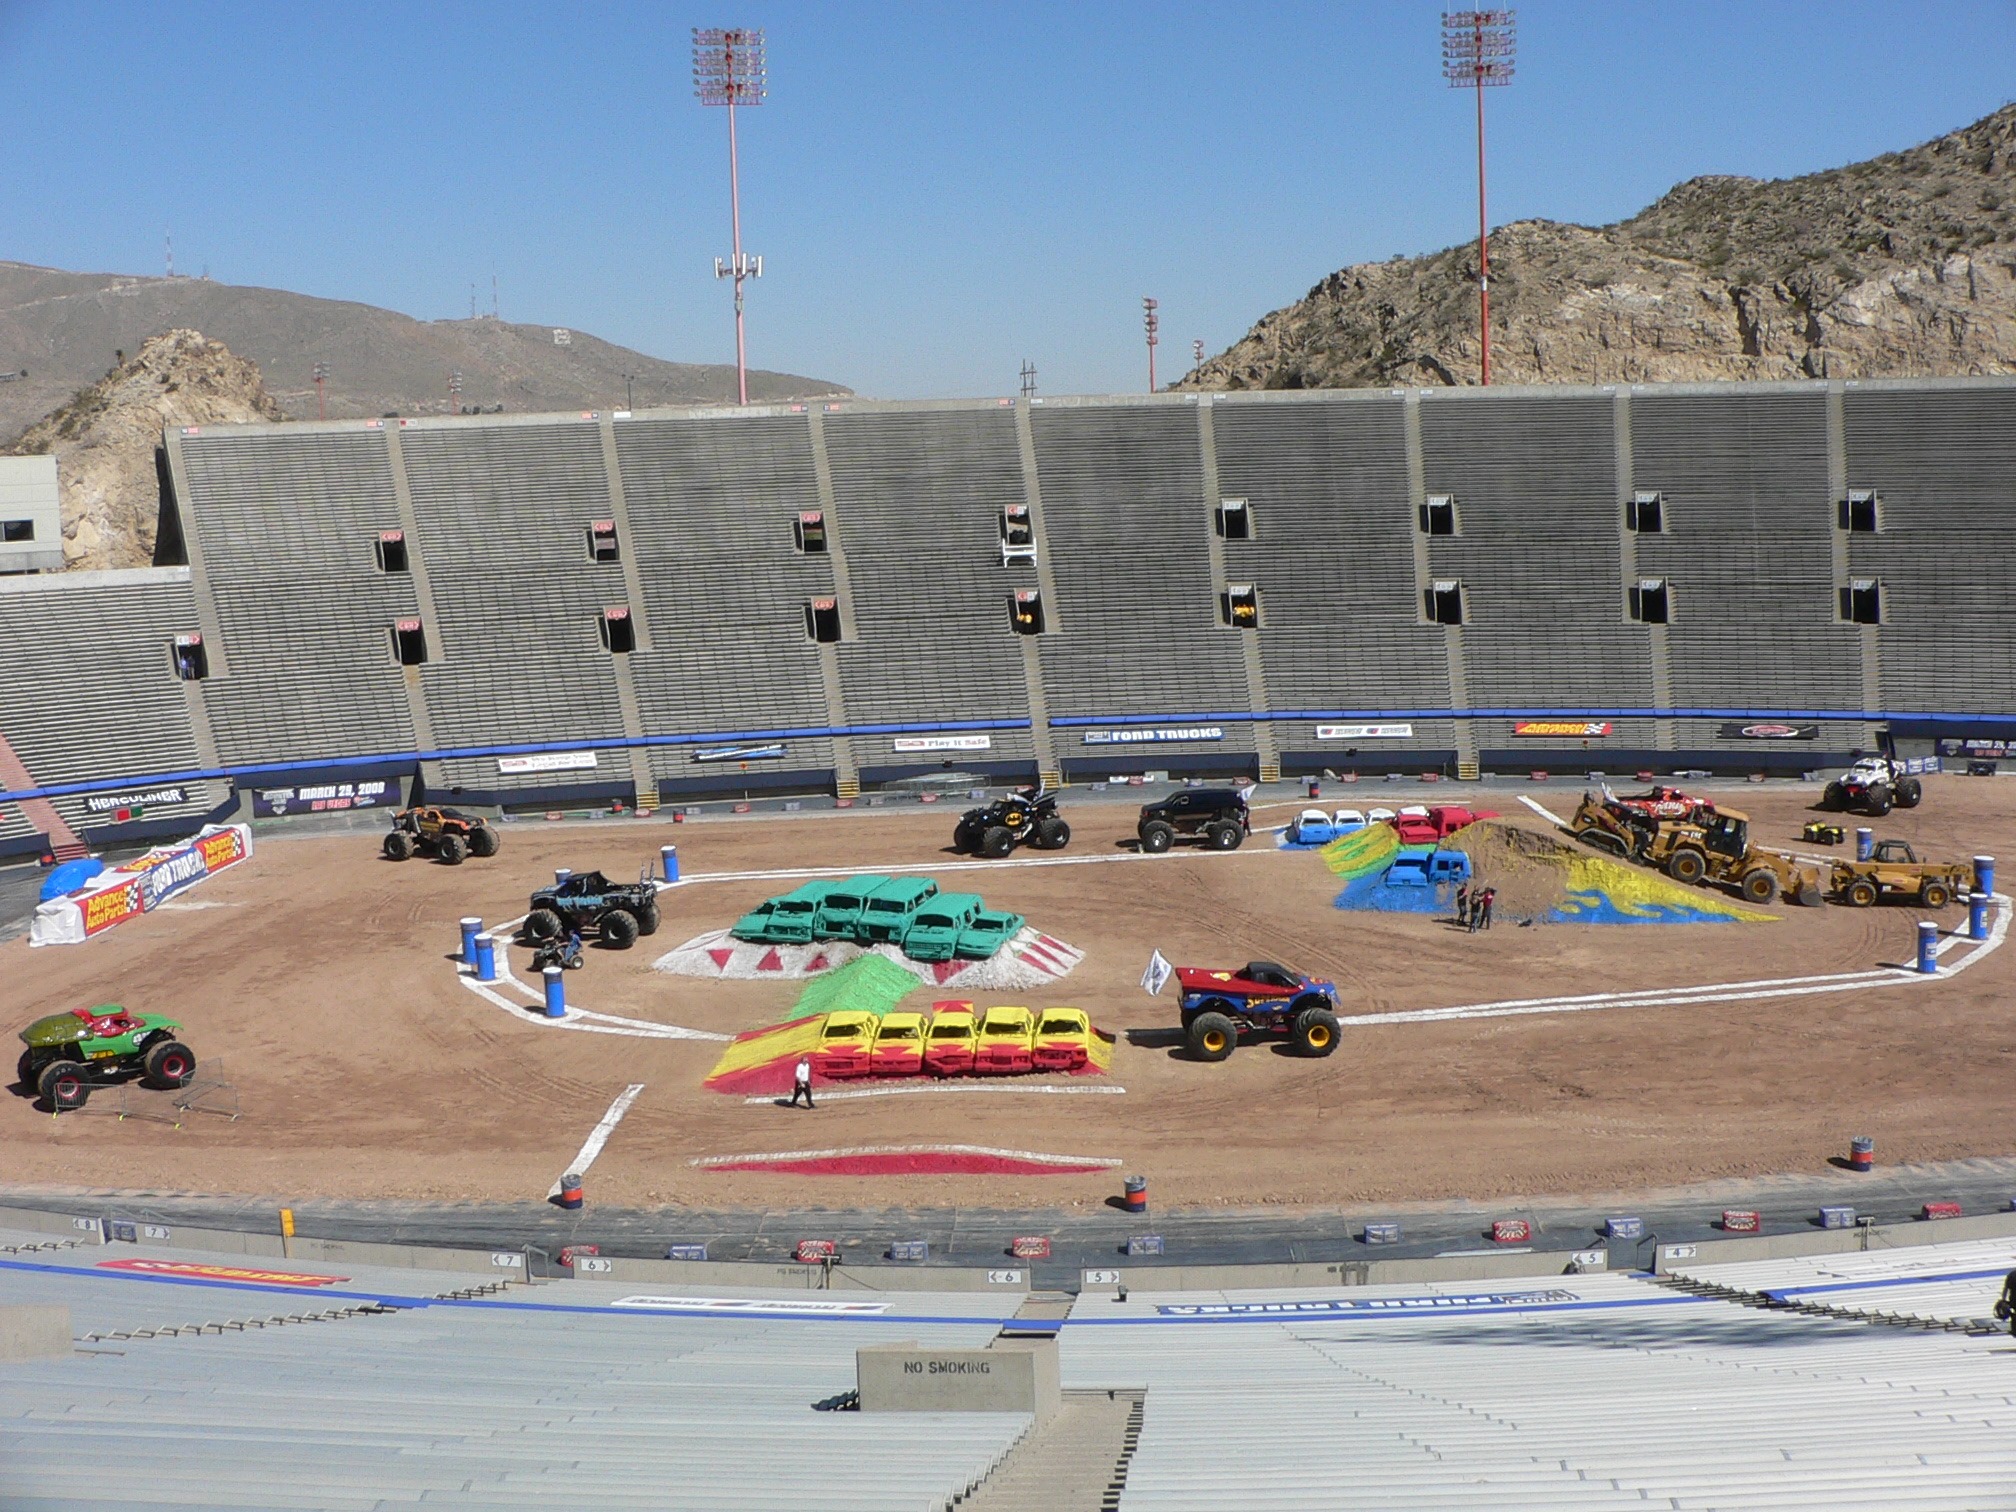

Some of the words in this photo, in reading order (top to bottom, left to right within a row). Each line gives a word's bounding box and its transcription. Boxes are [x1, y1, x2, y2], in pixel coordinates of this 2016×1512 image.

[300, 786, 336, 801] MARCH
[338, 784, 355, 798] 29,
[358, 781, 385, 795] 2008
[89, 789, 182, 811] HERCULINER
[88, 889, 125, 914] Advance
[86, 911, 105, 930] Auto
[1672, 1247, 1680, 1257] 4
[506, 1256, 514, 1265] 7
[1589, 1253, 1596, 1263] 5
[588, 1260, 596, 1270] 6
[1005, 1271, 1014, 1282] 6
[1095, 1272, 1102, 1282] 5
[904, 1361, 923, 1374] NO
[928, 1361, 990, 1374] SMOKING
